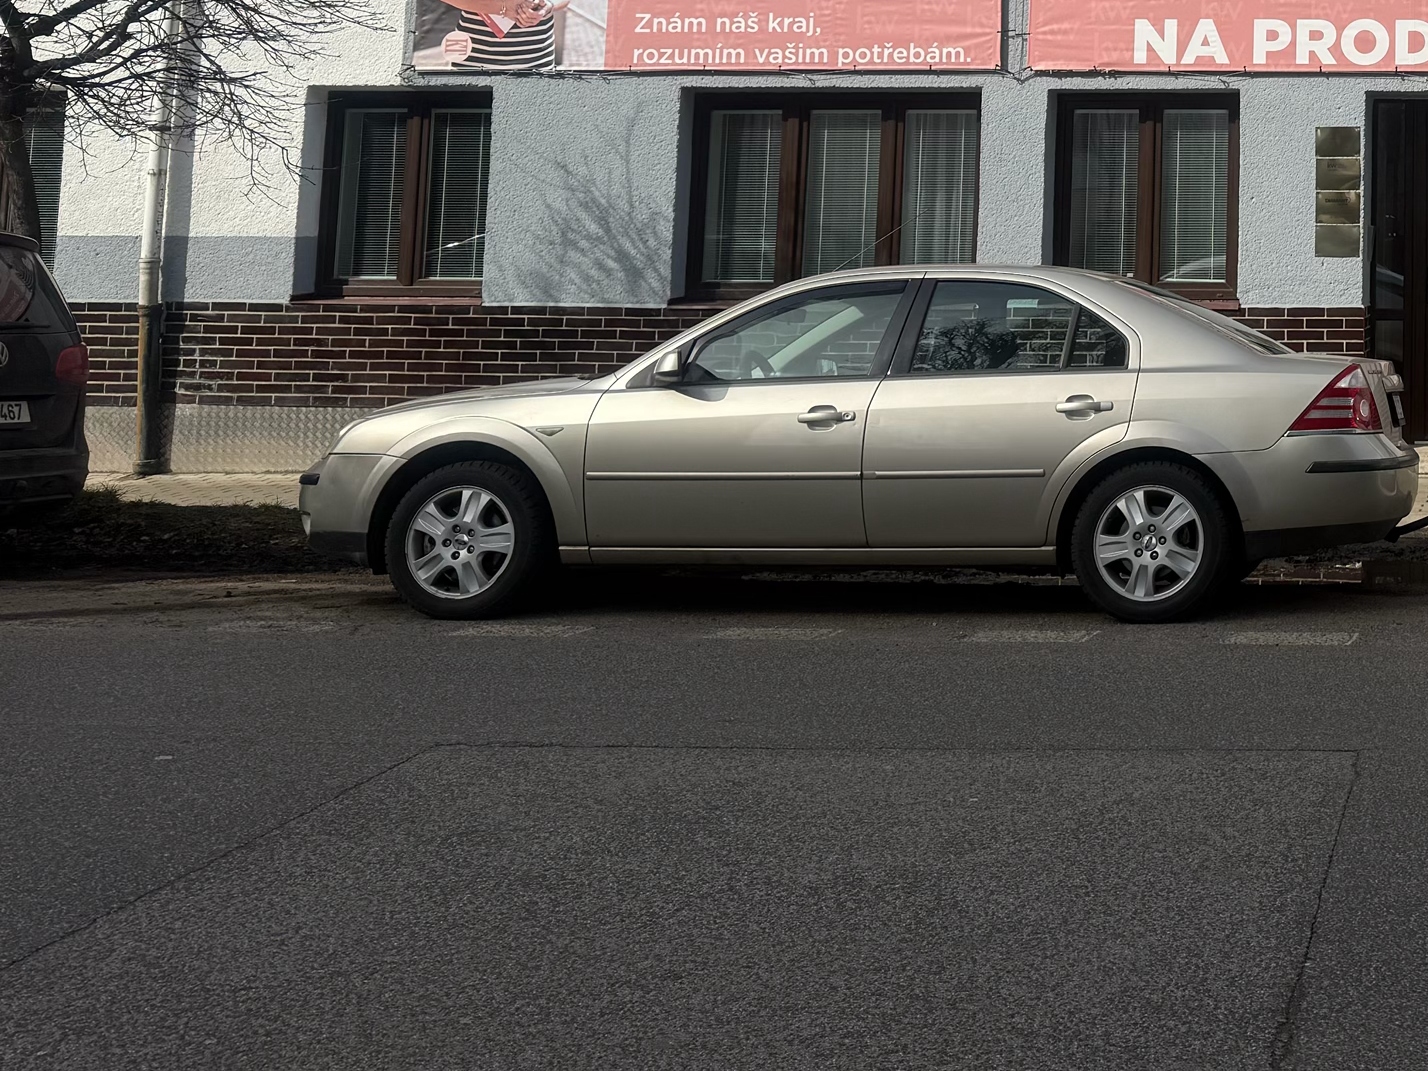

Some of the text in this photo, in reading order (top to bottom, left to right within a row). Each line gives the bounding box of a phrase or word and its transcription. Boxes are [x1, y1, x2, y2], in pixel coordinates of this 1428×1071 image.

[634, 12, 822, 36] Znám náš kraj,
[1133, 18, 1230, 65] NA
[632, 43, 972, 67] rozumím vašim potřebám.
[0, 403, 21, 420] 467
